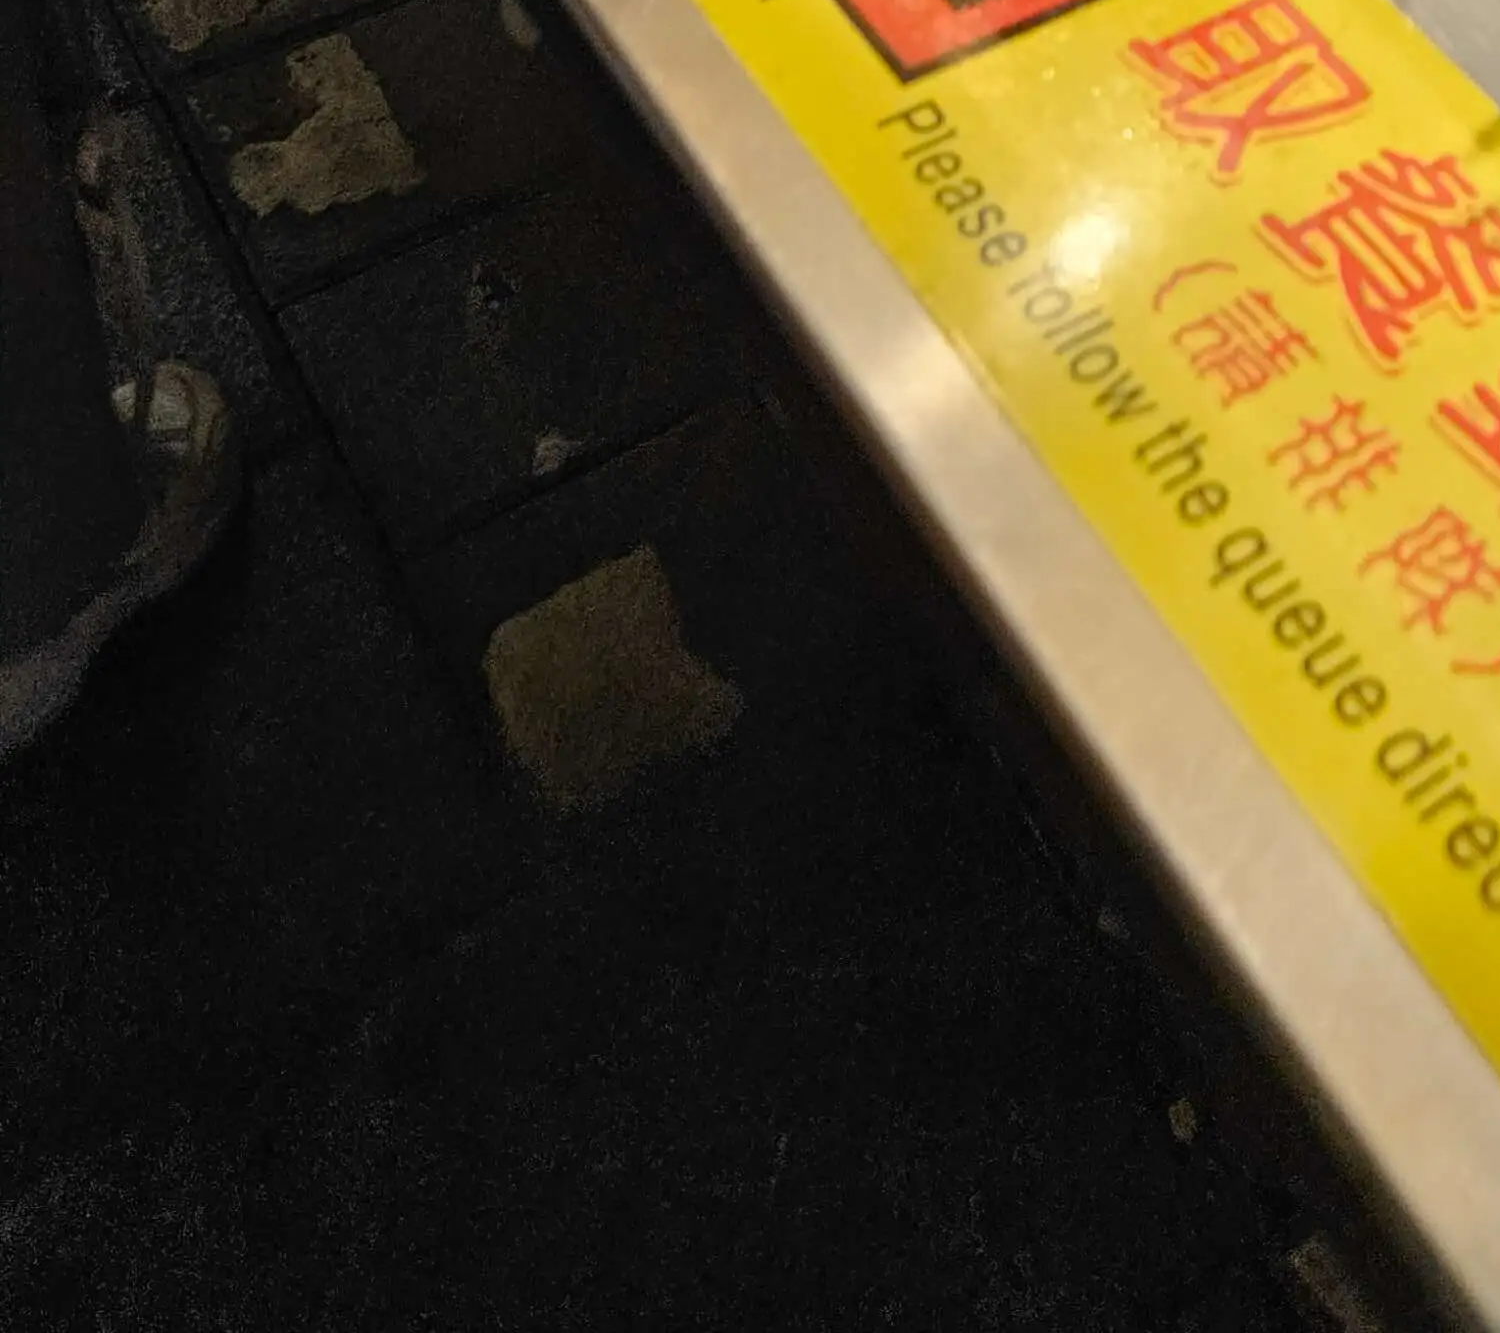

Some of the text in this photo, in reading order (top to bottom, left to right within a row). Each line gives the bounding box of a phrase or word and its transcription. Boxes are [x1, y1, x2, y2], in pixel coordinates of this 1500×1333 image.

[876, 99, 1029, 267] Please
[1006, 259, 1159, 428] follow
[1133, 418, 1231, 526] the
[1209, 525, 1389, 727] queue
